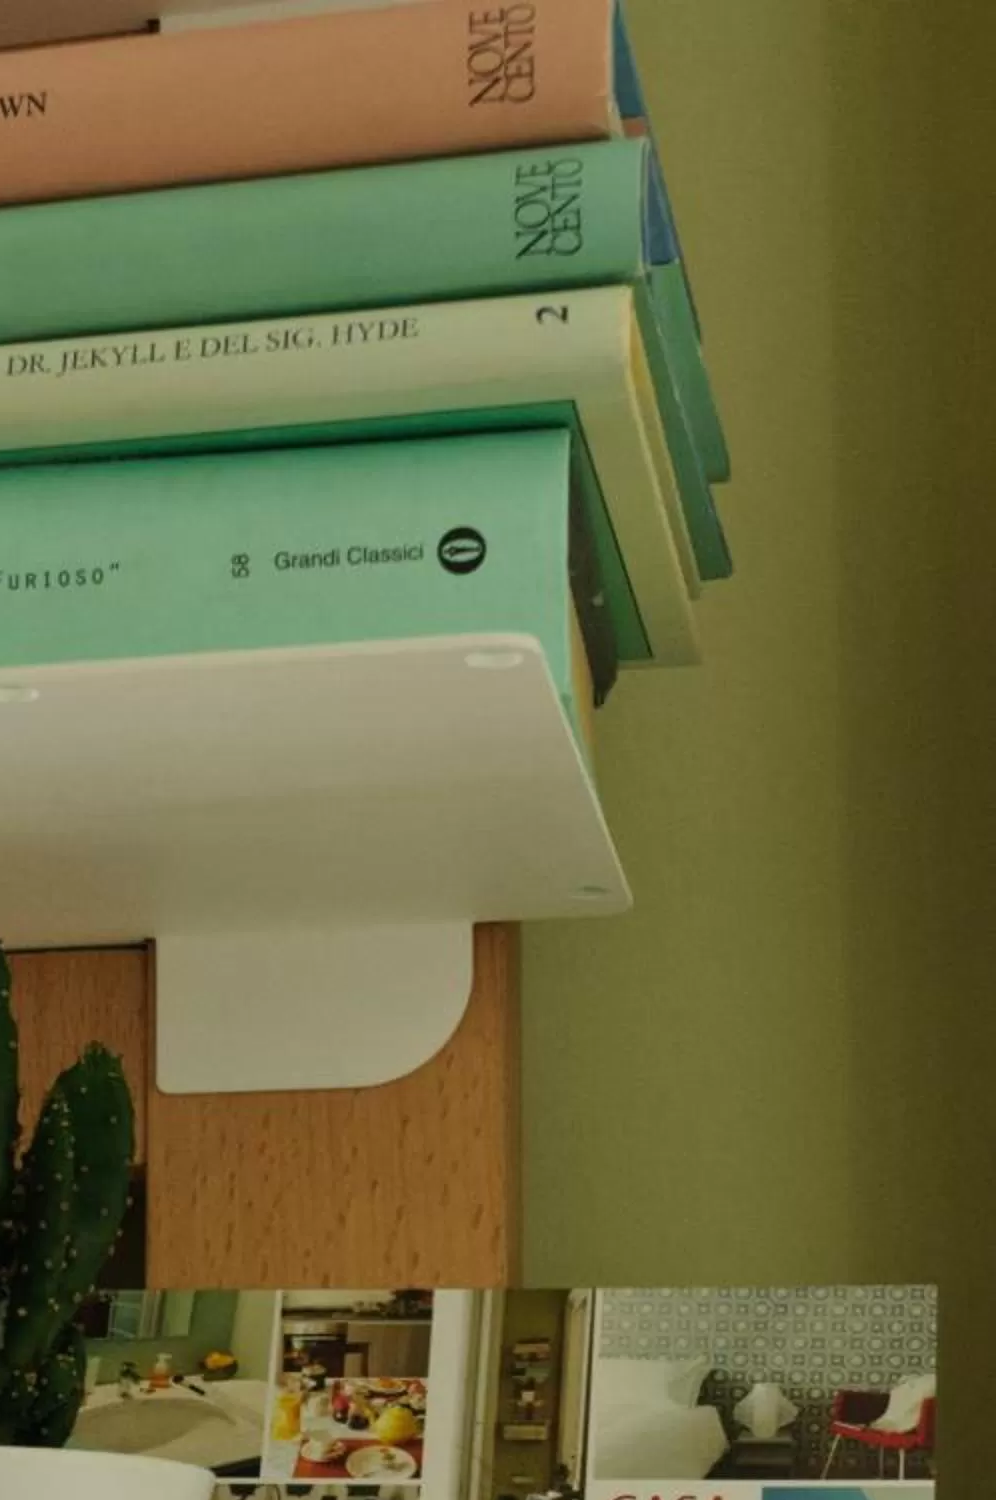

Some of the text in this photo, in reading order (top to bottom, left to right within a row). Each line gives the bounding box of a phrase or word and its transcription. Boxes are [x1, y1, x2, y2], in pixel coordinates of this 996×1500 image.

[468, 8, 504, 107] NOVE
[503, 3, 537, 104] CENTO
[515, 160, 553, 260] NOVE
[550, 157, 584, 257] CENTO
[7, 353, 52, 378] DR.
[56, 337, 166, 377] JEKYLL
[174, 338, 193, 362] E
[200, 332, 260, 359] DEL
[266, 325, 323, 353] SIG.
[331, 317, 420, 348] HYDE
[536, 304, 569, 325] 2
[274, 541, 424, 571] Grandi Classici
